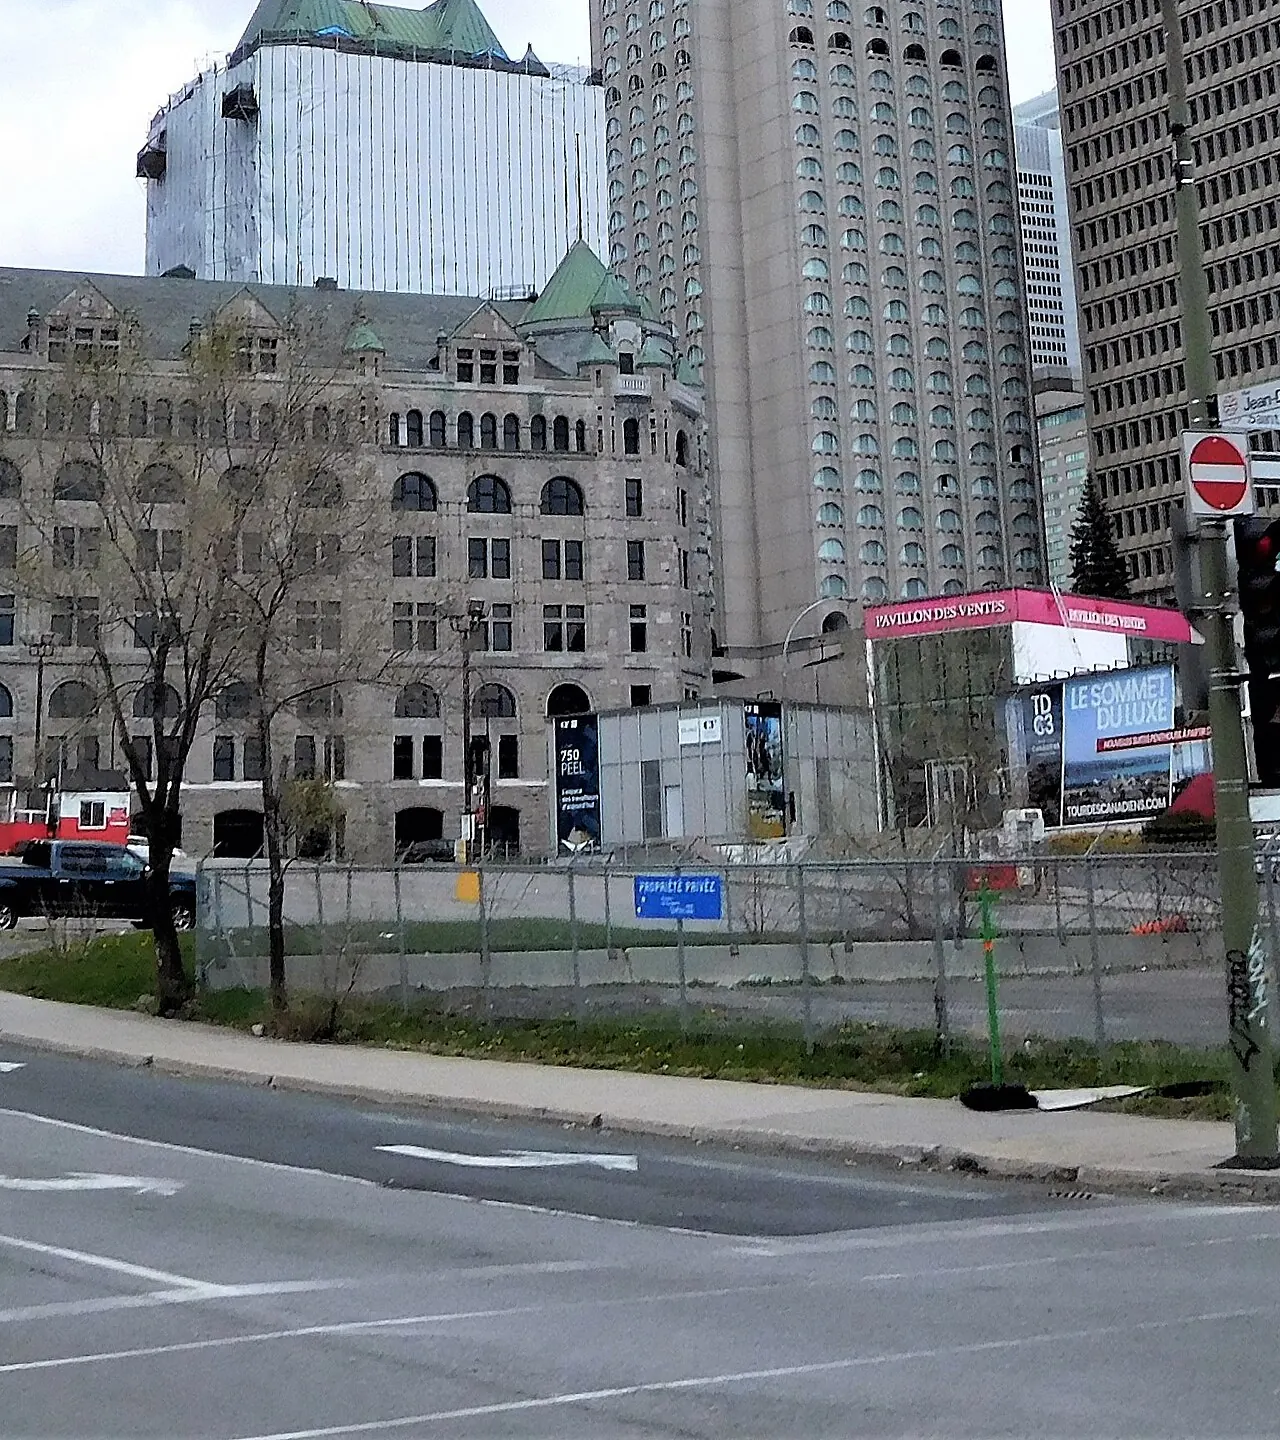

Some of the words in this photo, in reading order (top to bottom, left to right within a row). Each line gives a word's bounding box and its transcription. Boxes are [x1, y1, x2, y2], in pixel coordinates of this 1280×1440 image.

[875, 610, 932, 628] PAVILLON
[934, 607, 957, 621] DES
[957, 600, 1006, 617] VENTES
[1071, 686, 1088, 710] LE
[1091, 673, 1167, 707] SOMMET
[1031, 693, 1052, 716] TD
[1096, 704, 1124, 731] DU
[1124, 699, 1168, 727] LUXE
[560, 749, 580, 762] 750
[561, 761, 586, 776] PEEL
